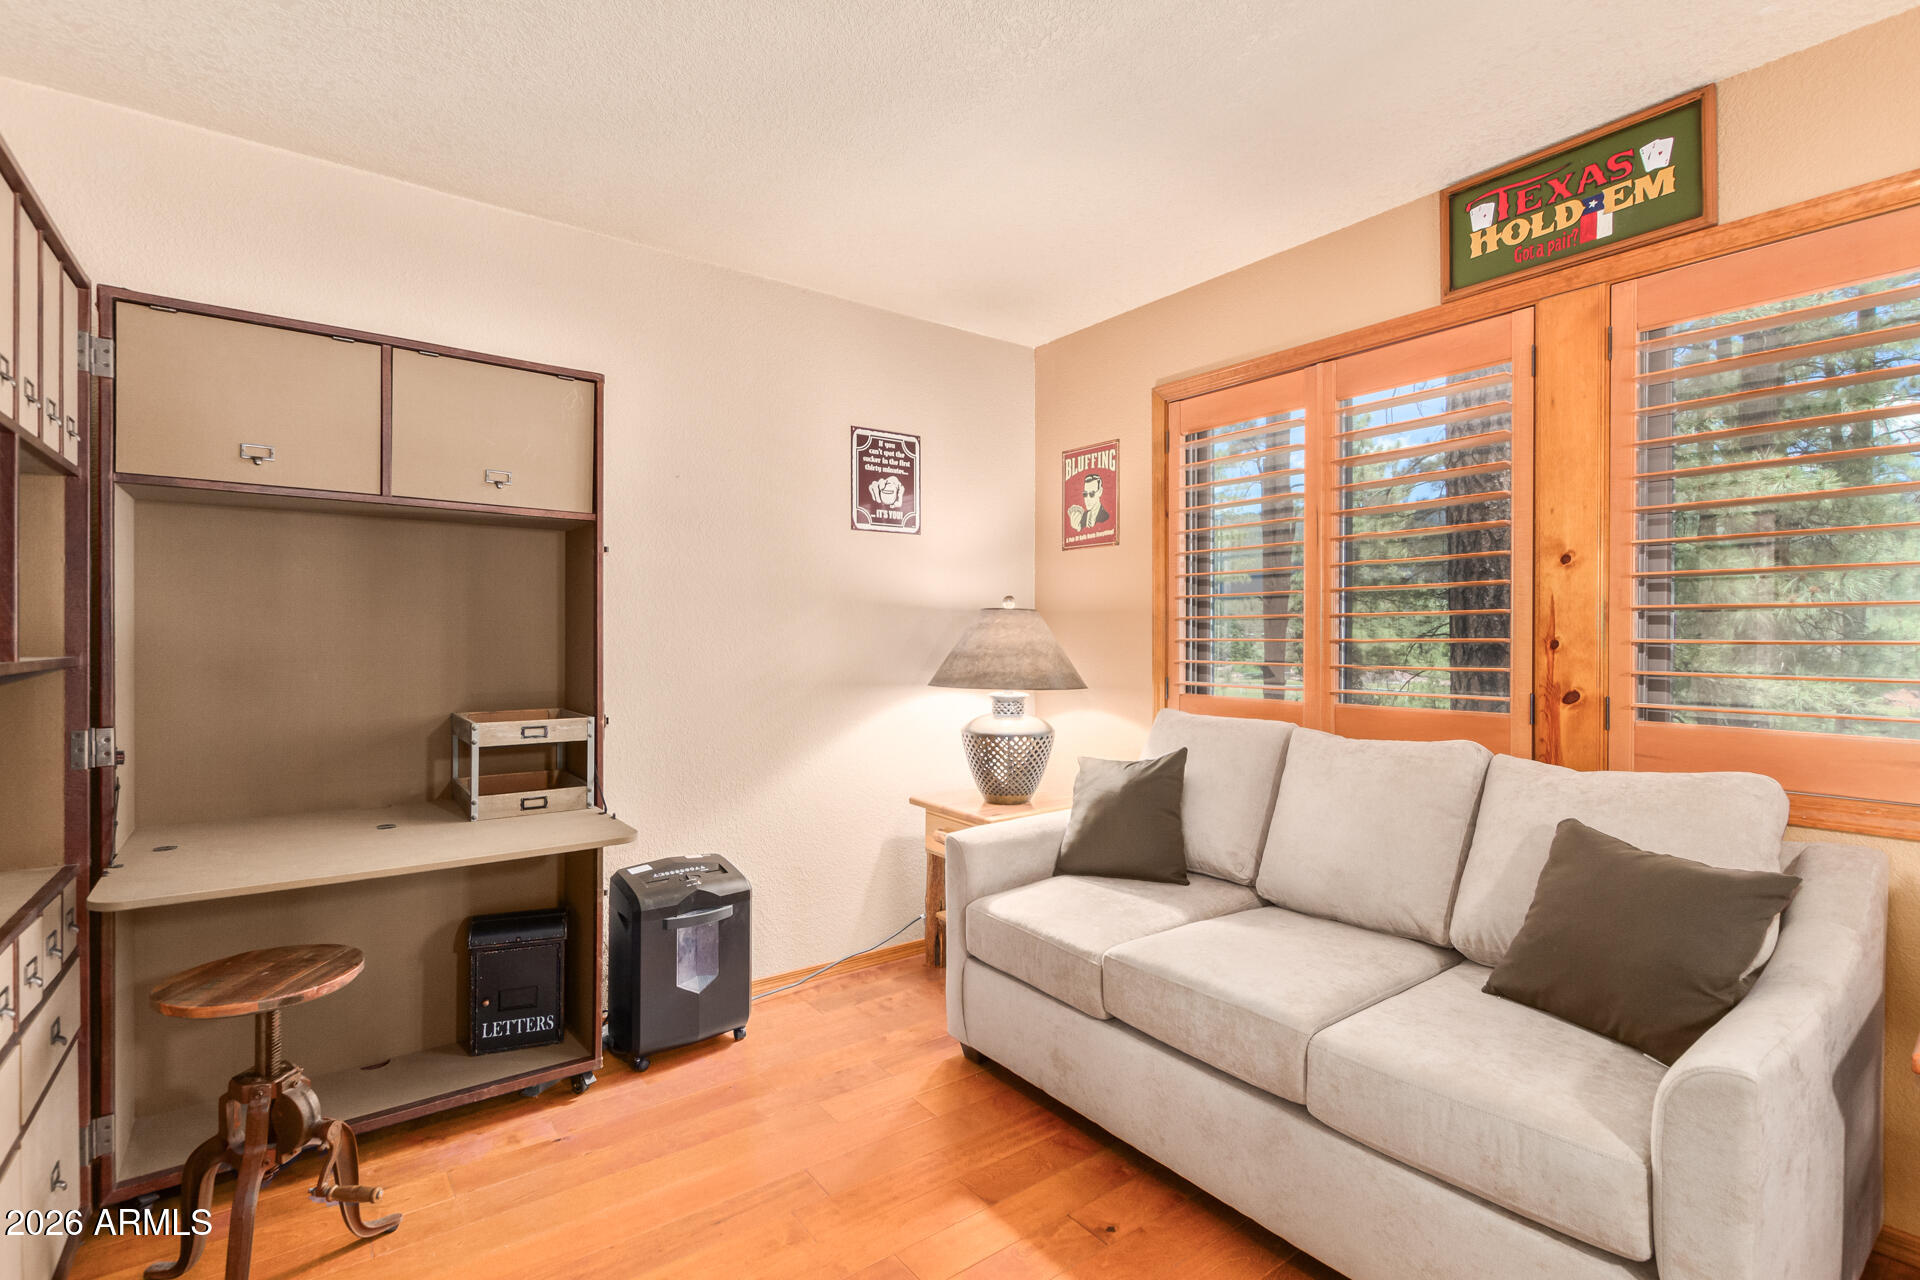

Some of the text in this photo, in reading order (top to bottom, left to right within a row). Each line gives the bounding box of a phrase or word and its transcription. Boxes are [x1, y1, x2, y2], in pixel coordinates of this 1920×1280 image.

[1465, 149, 1634, 221] TEXAS
[1470, 199, 1585, 259] HOLD
[1514, 227, 1579, 263] Got a pair?
[863, 455, 881, 463] sucker
[864, 464, 882, 472] thirty
[1065, 448, 1117, 481] BLUFFING
[482, 1014, 555, 1039] LETTERS
